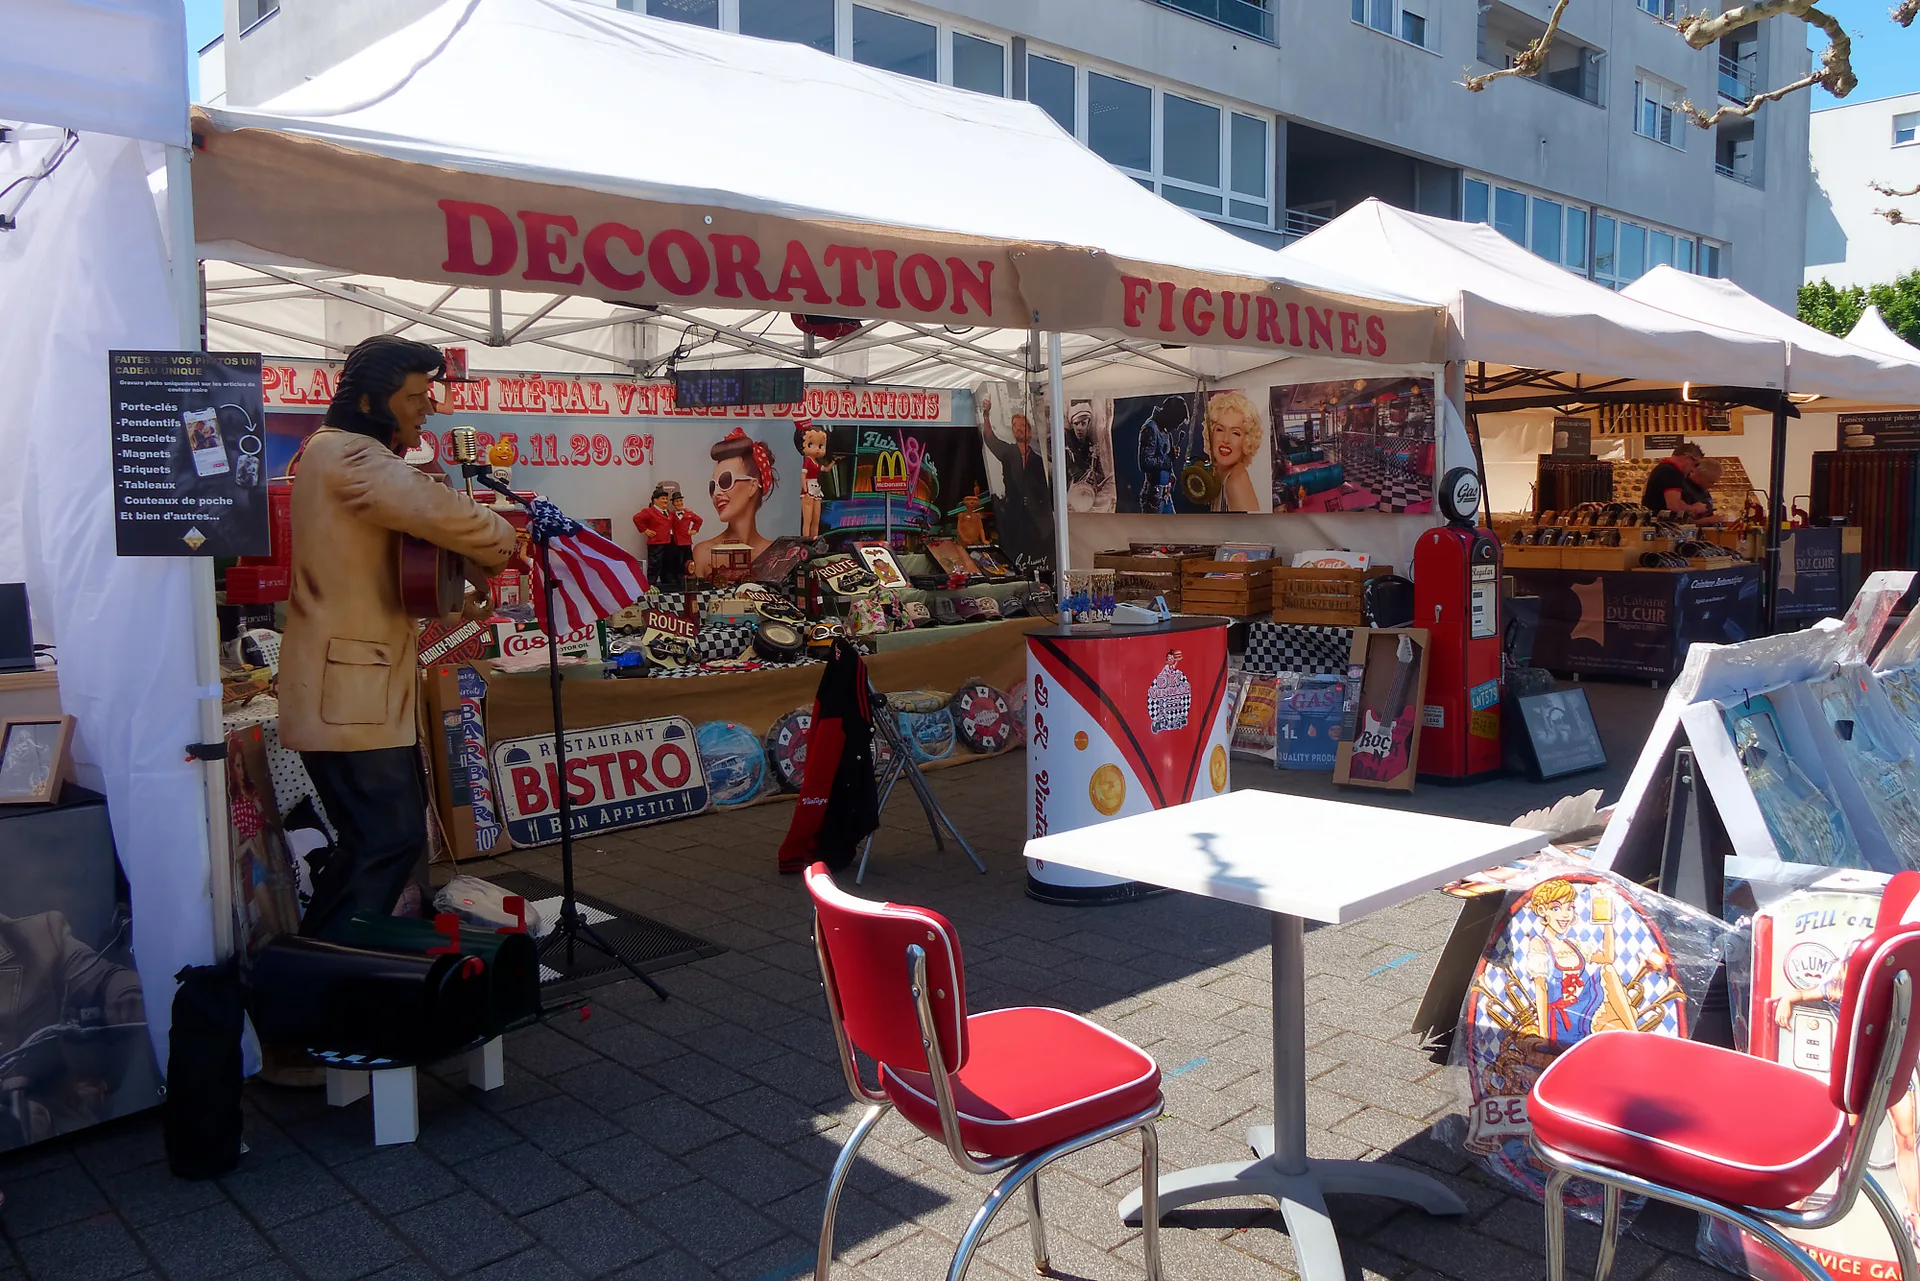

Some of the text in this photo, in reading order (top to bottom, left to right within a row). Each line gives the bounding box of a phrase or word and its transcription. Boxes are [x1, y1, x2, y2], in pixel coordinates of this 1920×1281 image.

[438, 199, 995, 318] DECORATION
[1120, 275, 1387, 357] FIGURINES
[115, 356, 150, 364] FAITES
[171, 357, 192, 365] VOS
[196, 357, 238, 365] PHOTOS
[242, 358, 256, 366] UN
[115, 367, 203, 375] CADEAU UNIQUE
[497, 372, 609, 415] MÉTAL
[682, 379, 739, 402] WED
[120, 402, 178, 412] Porte-clés
[863, 431, 898, 450] Flo's
[1457, 483, 1478, 499] Gas
[124, 496, 234, 506] Couteaux de poche
[120, 511, 133, 520] Et
[136, 511, 160, 520] bien
[819, 560, 858, 578] ROUTE
[1812, 557, 1835, 570] CUIR
[1622, 595, 1667, 608] Cabane
[1606, 606, 1666, 623] DU CUIR
[649, 612, 695, 637] ROUTE
[557, 642, 589, 652] OTOR OIL
[1292, 691, 1335, 709] GAS
[511, 743, 692, 816] BISTRO
[802, 797, 829, 806] Vintage
[600, 798, 675, 825] APPETIT
[1794, 909, 1837, 935] Fill
